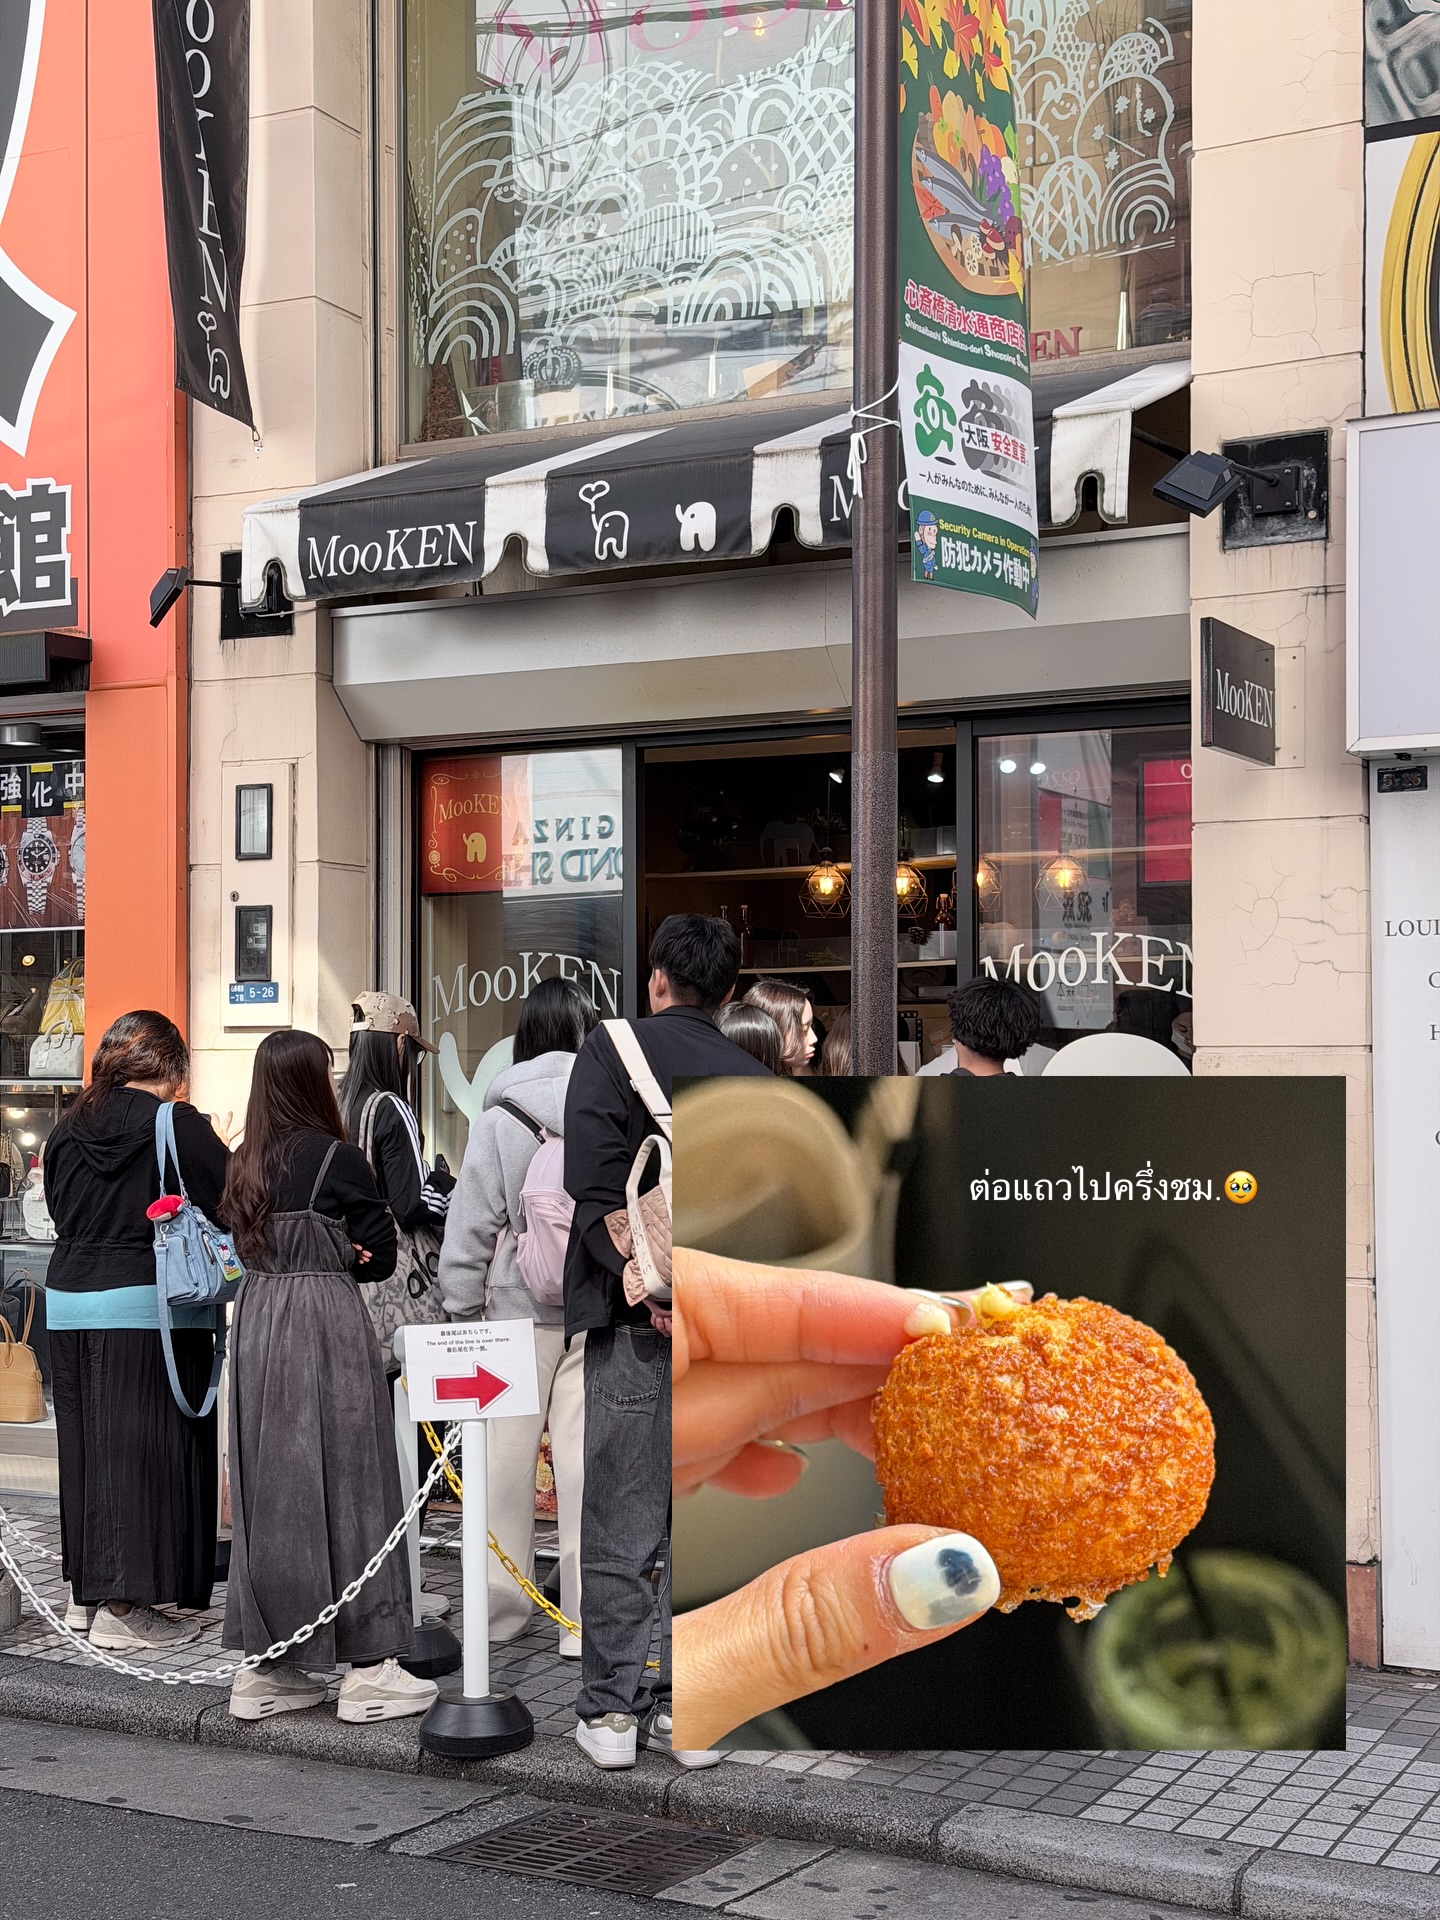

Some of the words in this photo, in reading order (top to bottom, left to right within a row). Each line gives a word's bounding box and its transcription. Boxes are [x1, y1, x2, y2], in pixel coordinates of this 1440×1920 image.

[942, 331, 984, 356] Shimizu-dori
[984, 344, 1017, 366] Shopping
[964, 424, 990, 450] 大阪
[939, 519, 972, 538] Security
[972, 528, 999, 545] Camera
[999, 535, 1006, 546] in
[307, 521, 477, 579] MooKEN
[941, 536, 1030, 593] 防犯カメラ作動中
[1216, 668, 1274, 729] MooKEN
[439, 793, 514, 824] MooKEN
[249, 987, 275, 998] 5-26
